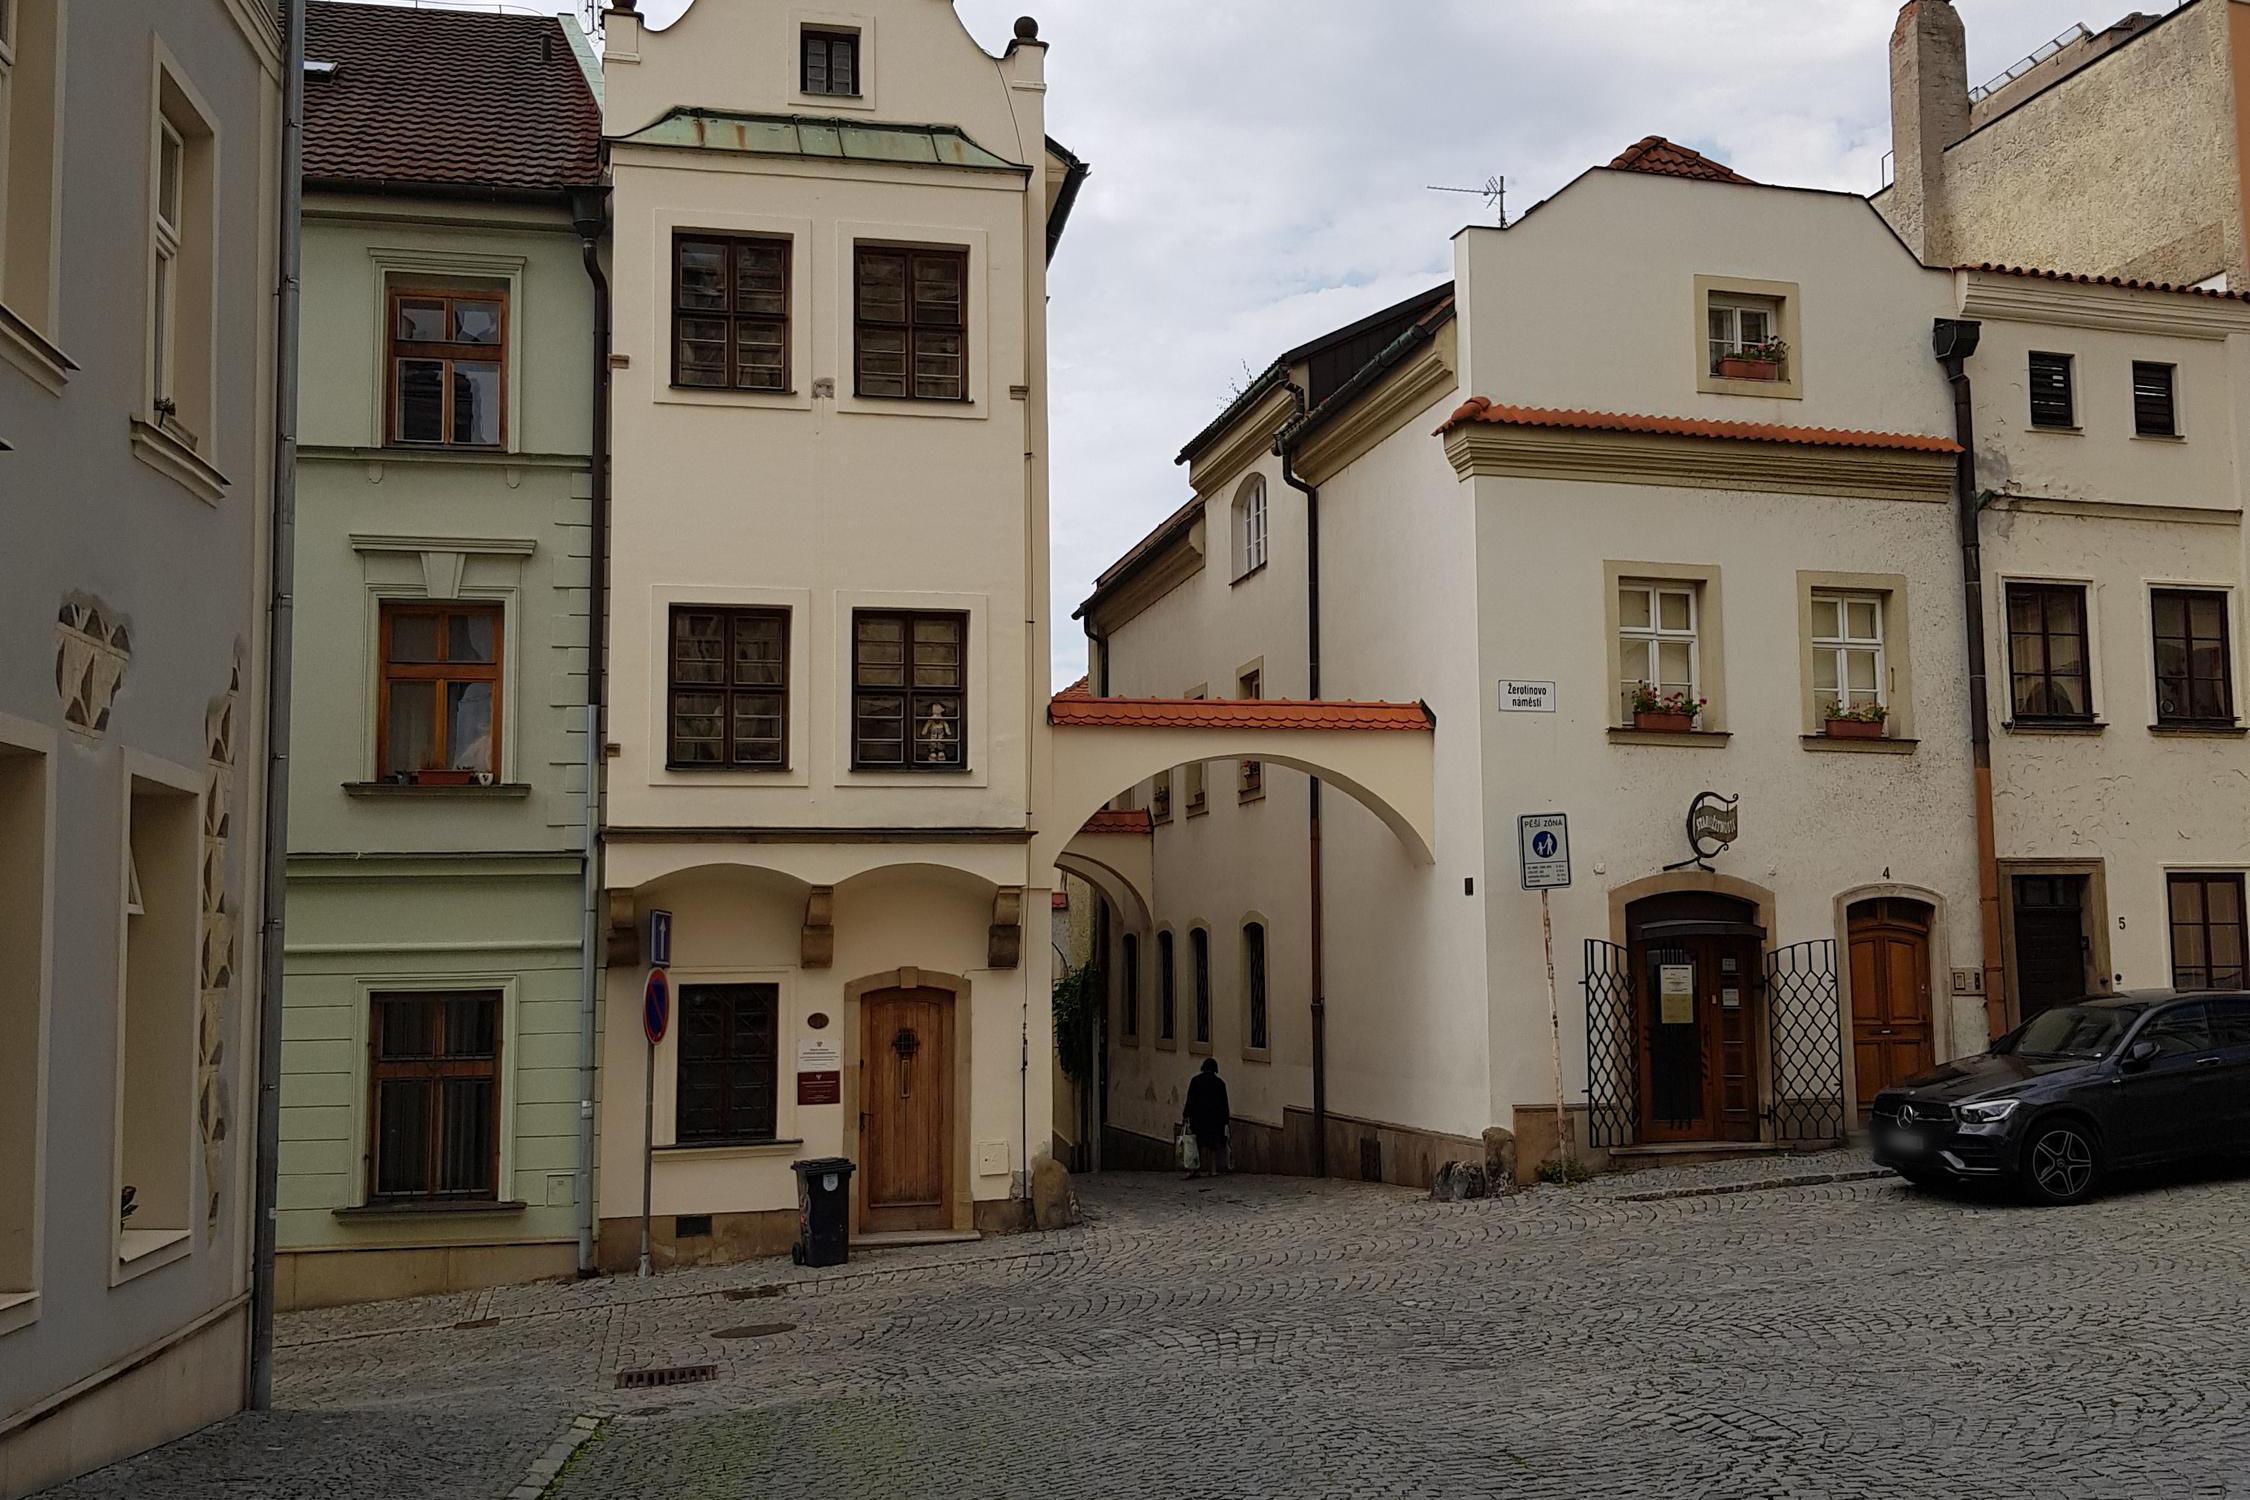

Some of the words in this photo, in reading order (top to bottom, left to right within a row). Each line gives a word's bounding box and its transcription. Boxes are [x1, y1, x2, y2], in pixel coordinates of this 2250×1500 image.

[1507, 682, 1547, 696] Žerotínovo
[1512, 696, 1542, 708] náměstí
[1882, 866, 1890, 880] 4
[2118, 916, 2126, 930] 5
